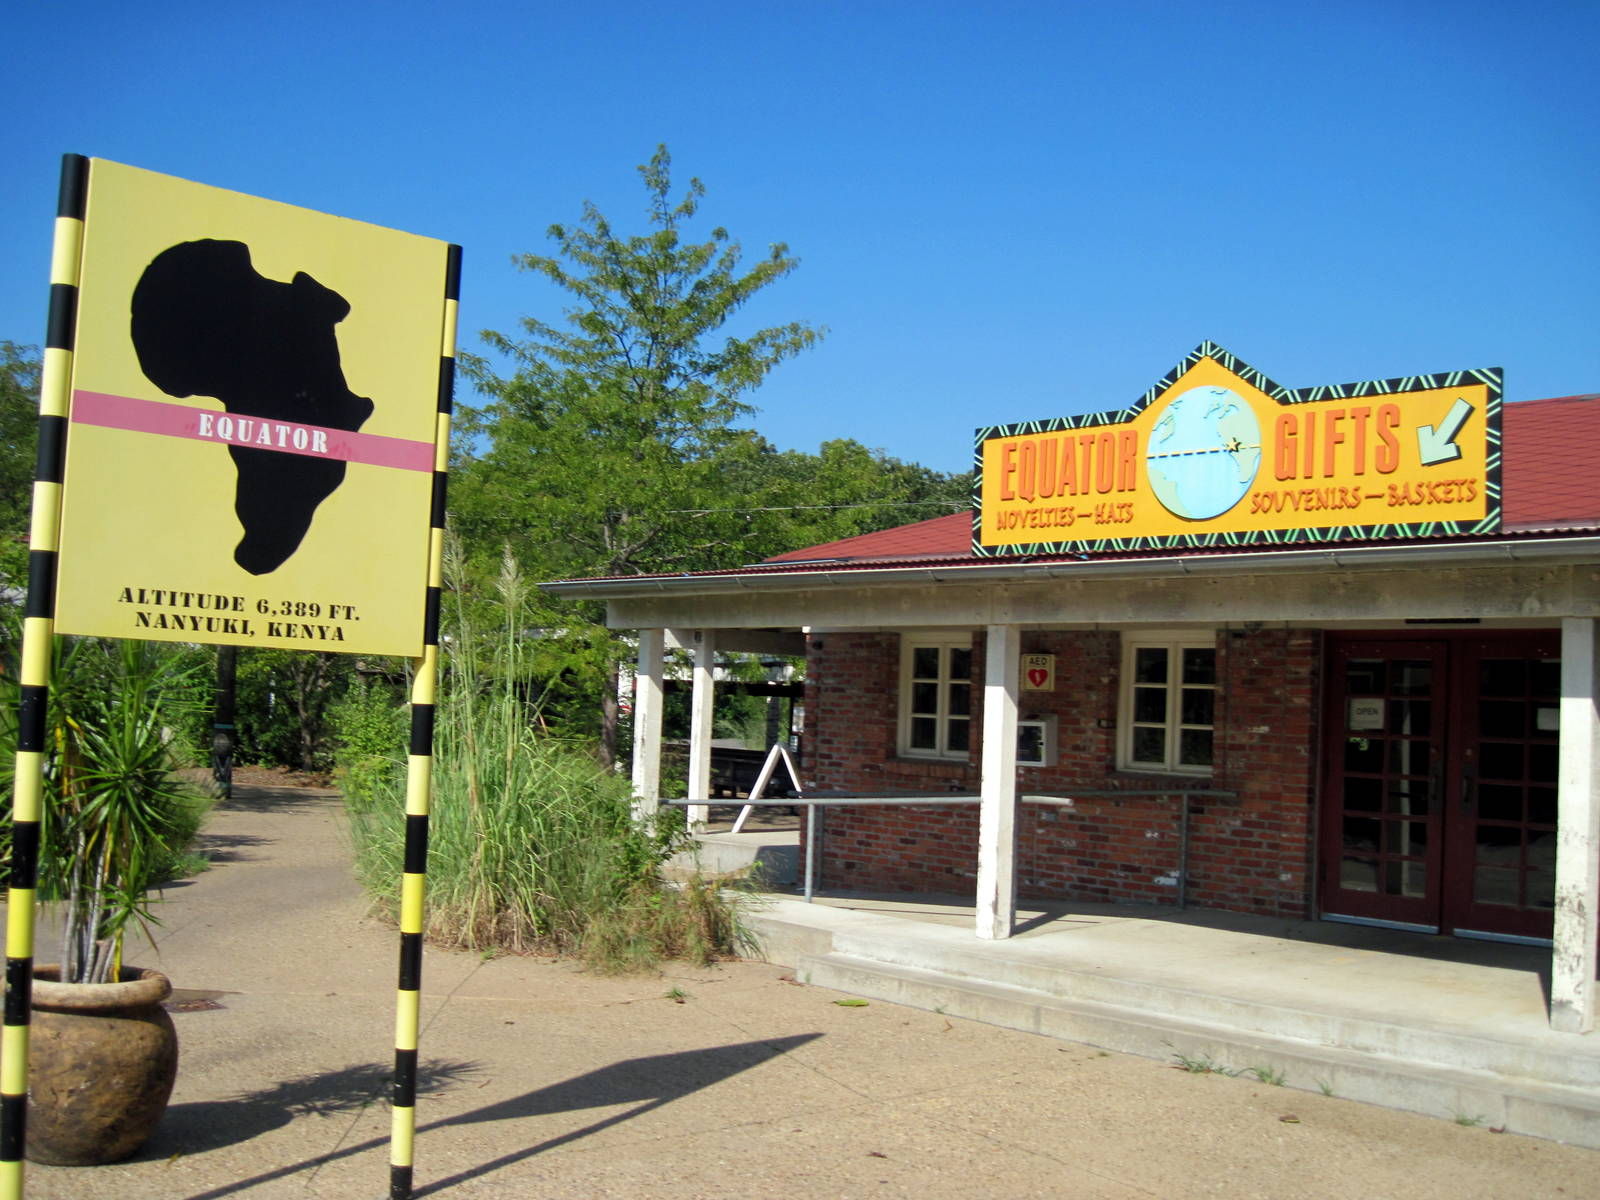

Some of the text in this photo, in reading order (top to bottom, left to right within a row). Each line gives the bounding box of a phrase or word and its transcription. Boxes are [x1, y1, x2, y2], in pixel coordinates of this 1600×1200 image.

[199, 413, 329, 454] EQUATOR
[1275, 404, 1401, 480] GIFTS
[1000, 431, 1138, 502] EQUATOR
[119, 587, 360, 622] ALTITUDE 6,389 FT.
[135, 613, 345, 641] NANYUKI, KENYA
[1029, 657, 1048, 665] AED
